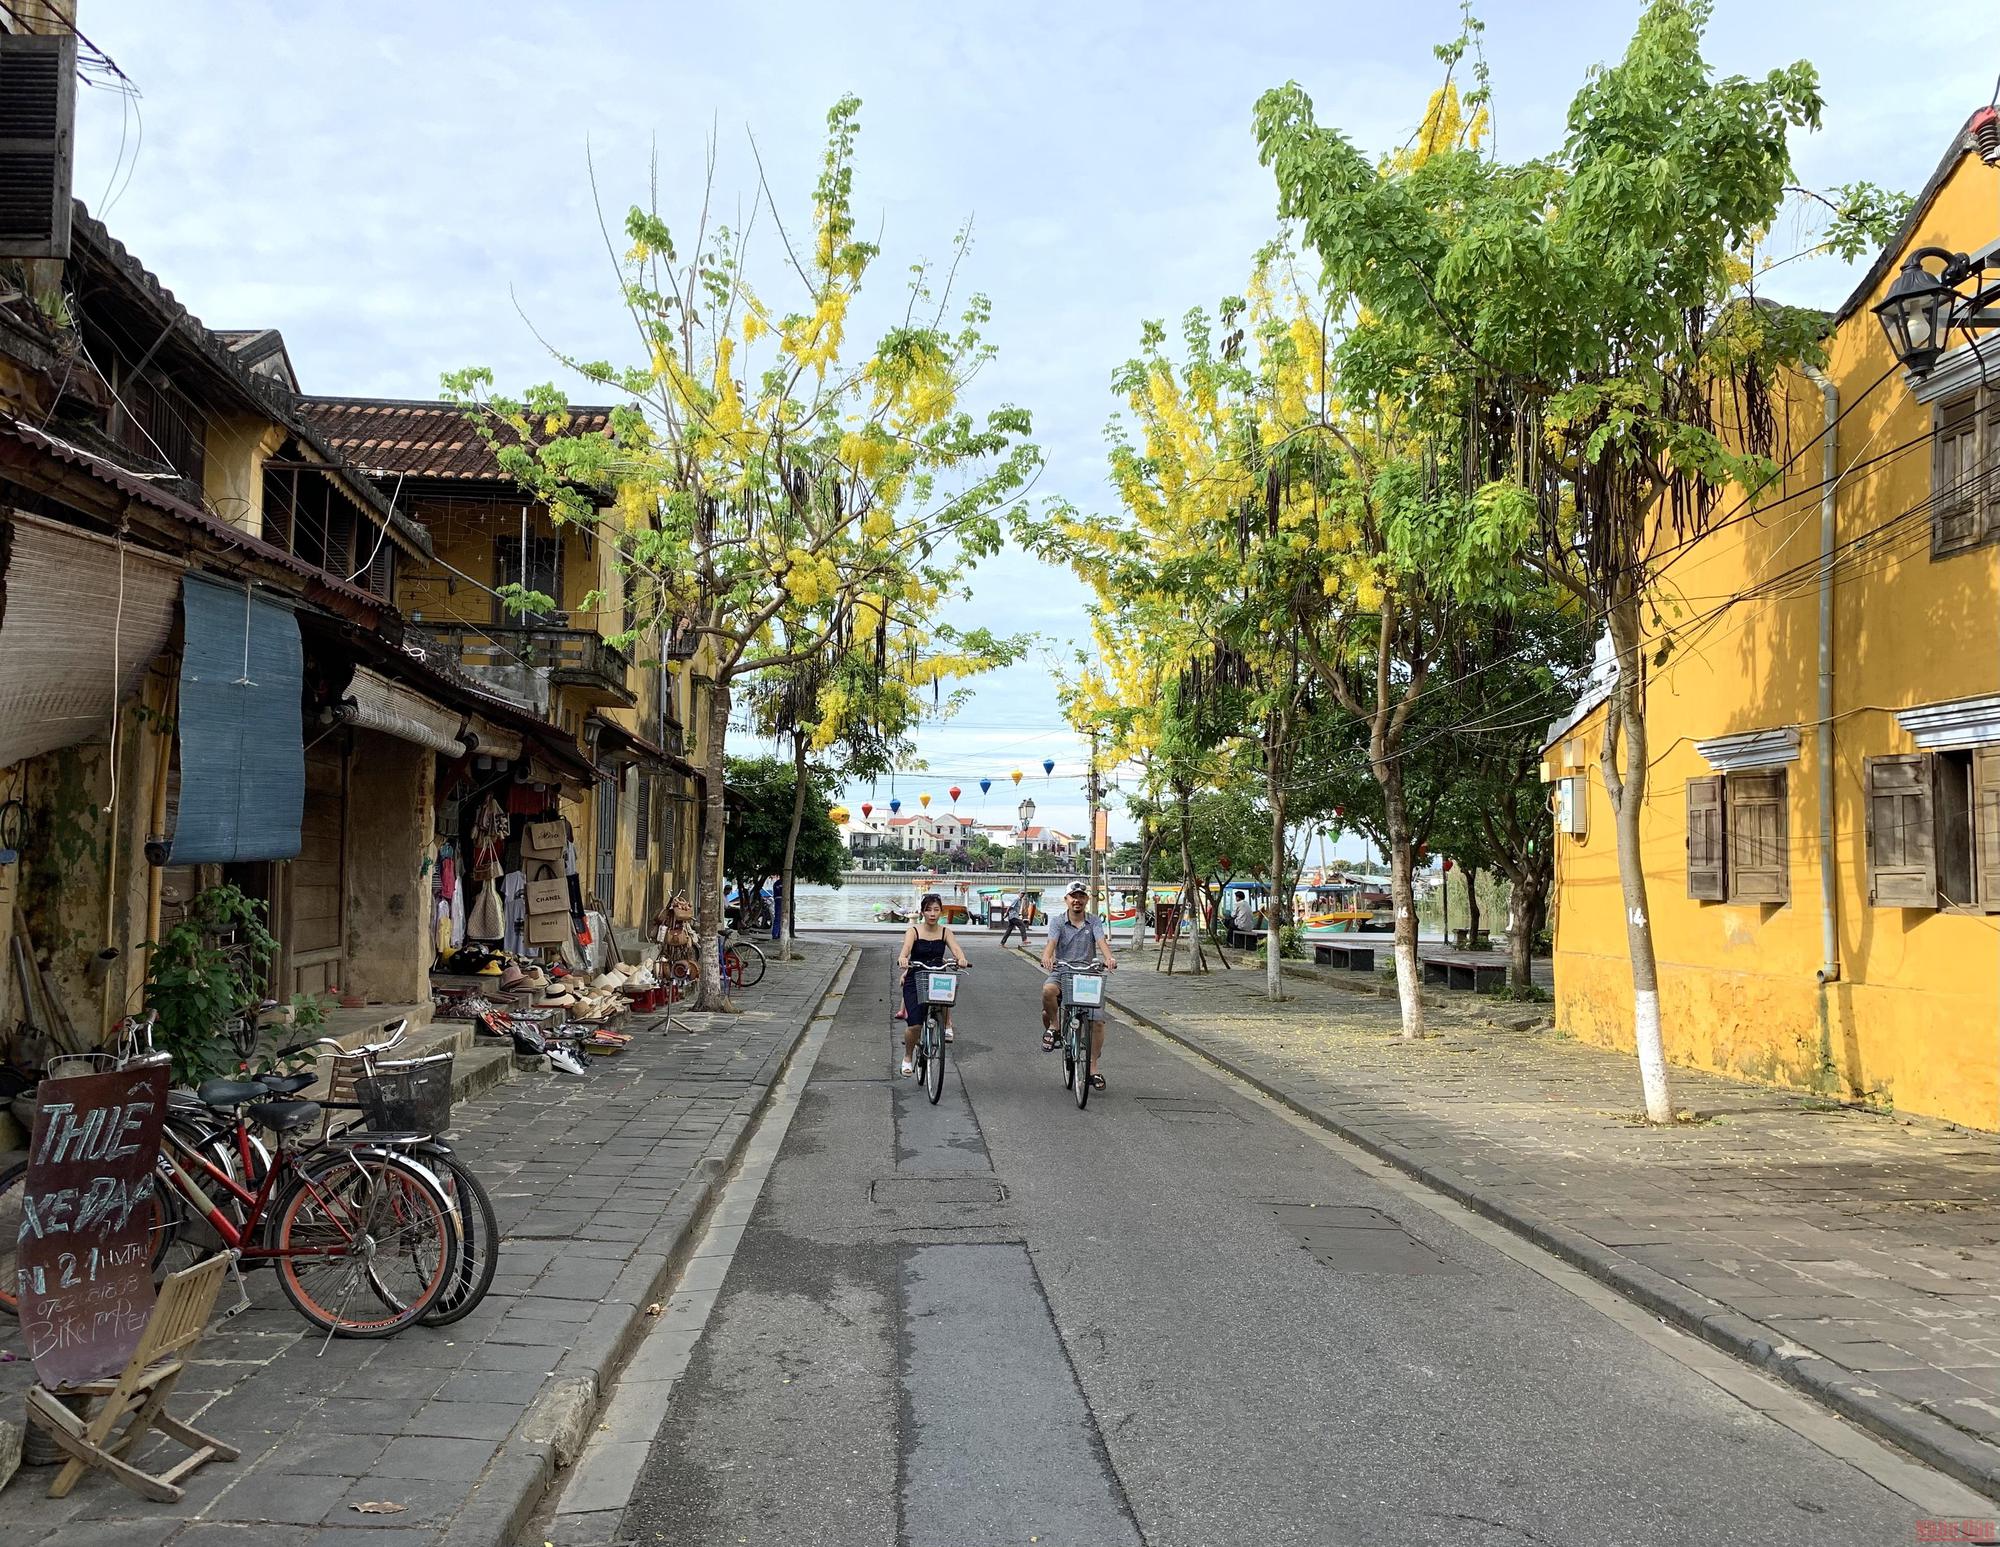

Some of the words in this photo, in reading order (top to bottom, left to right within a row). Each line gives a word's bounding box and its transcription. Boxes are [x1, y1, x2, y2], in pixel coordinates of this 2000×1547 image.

[535, 894, 561, 903] CHANEL
[1397, 906, 1409, 919] 16
[1629, 907, 1648, 928] 14
[35, 1078, 155, 1166] THUÊ
[16, 1186, 79, 1244] XE
